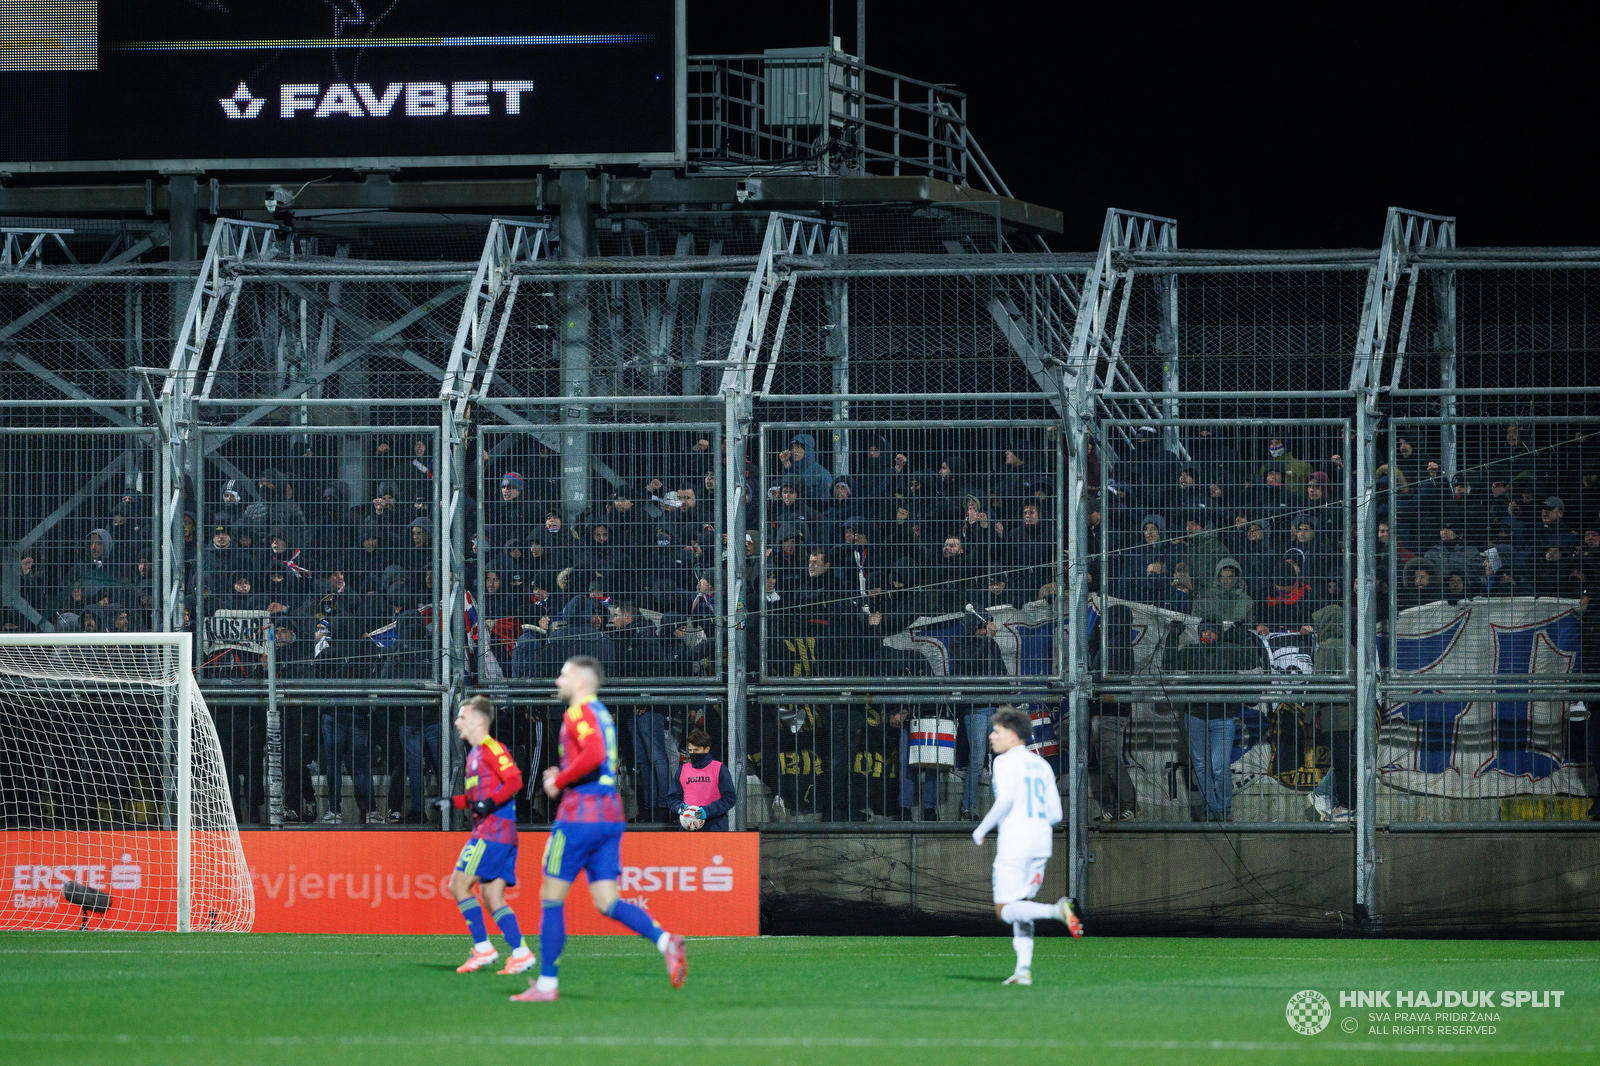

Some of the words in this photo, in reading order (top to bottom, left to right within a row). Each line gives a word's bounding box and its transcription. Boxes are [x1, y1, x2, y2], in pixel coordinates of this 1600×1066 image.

[280, 80, 534, 118] FAVBET
[1025, 777, 1047, 818] 19
[14, 865, 106, 889] ERSTE
[617, 866, 698, 892] RSTE
[14, 893, 59, 908] Bank
